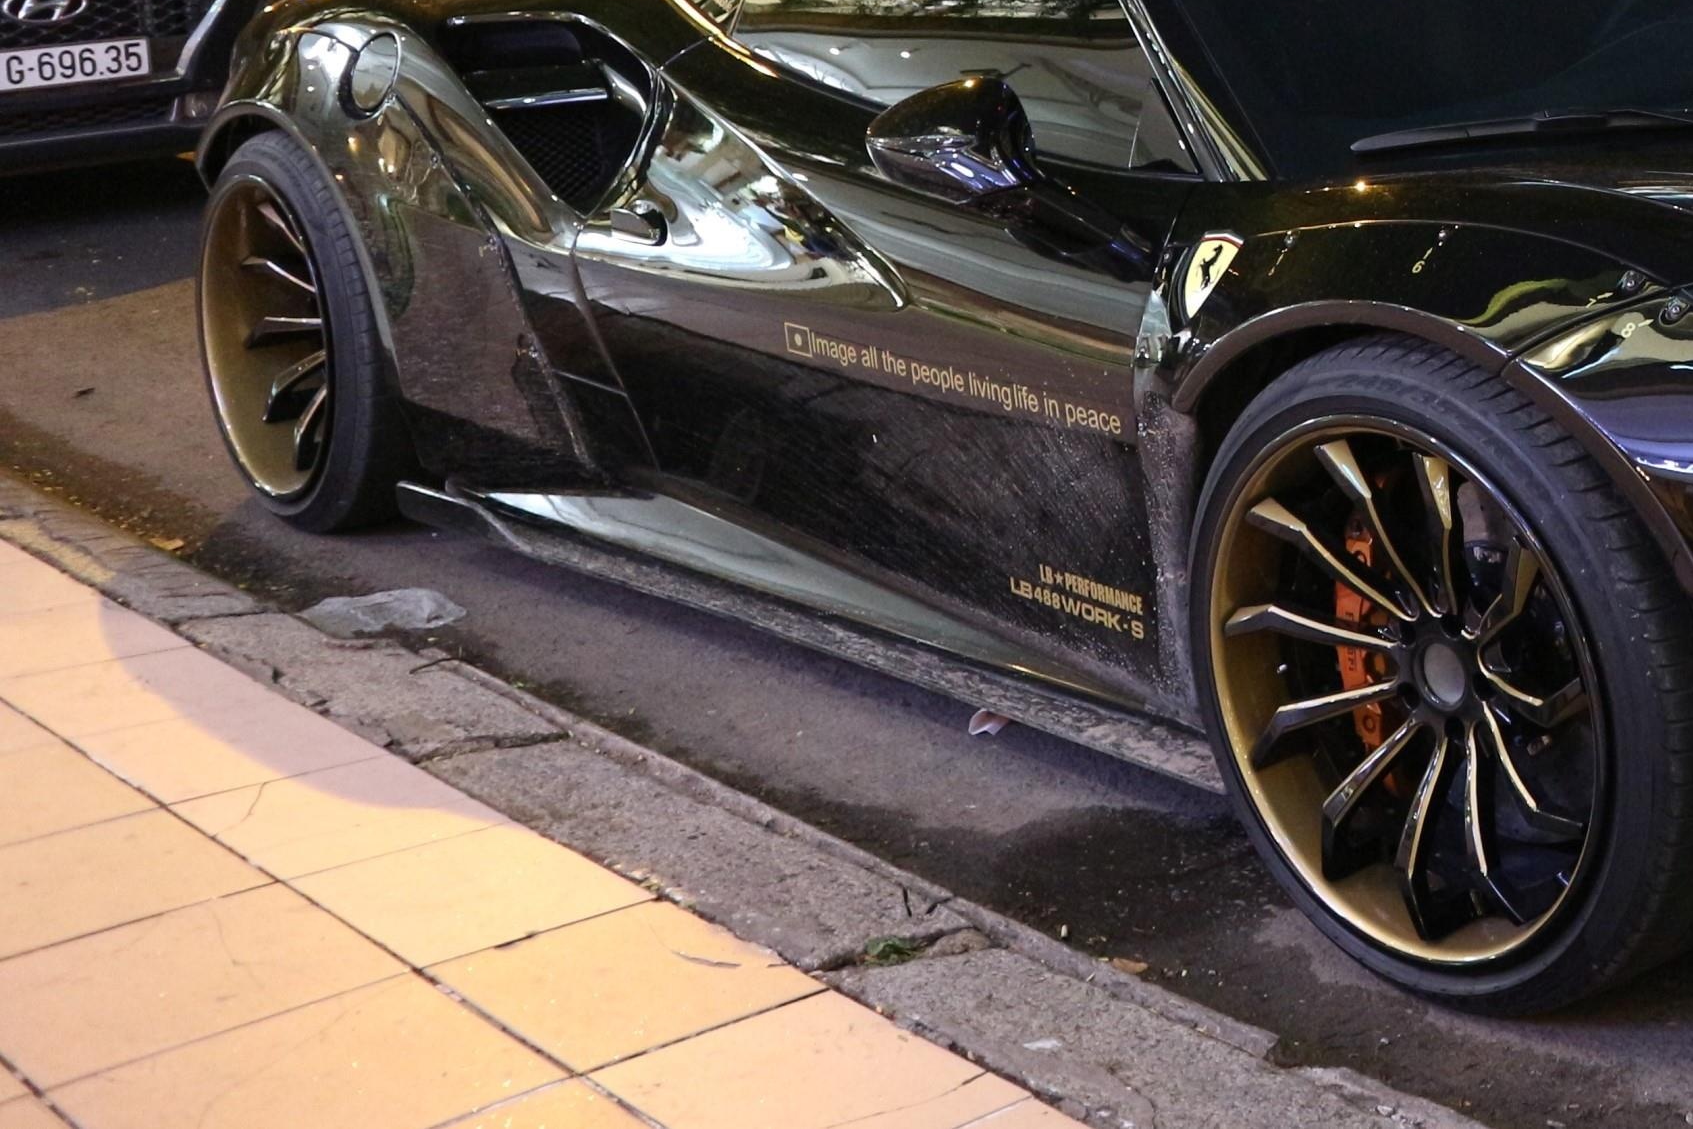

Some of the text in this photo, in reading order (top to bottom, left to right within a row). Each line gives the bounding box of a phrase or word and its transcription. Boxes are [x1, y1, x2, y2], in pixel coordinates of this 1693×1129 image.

[6, 42, 142, 85] G-696.35
[1620, 322, 1637, 340] 8
[810, 333, 858, 367] Image
[860, 347, 879, 370] all
[881, 351, 907, 377] the
[910, 361, 965, 394] people
[1043, 391, 1060, 419] in
[1065, 402, 1122, 435] peace
